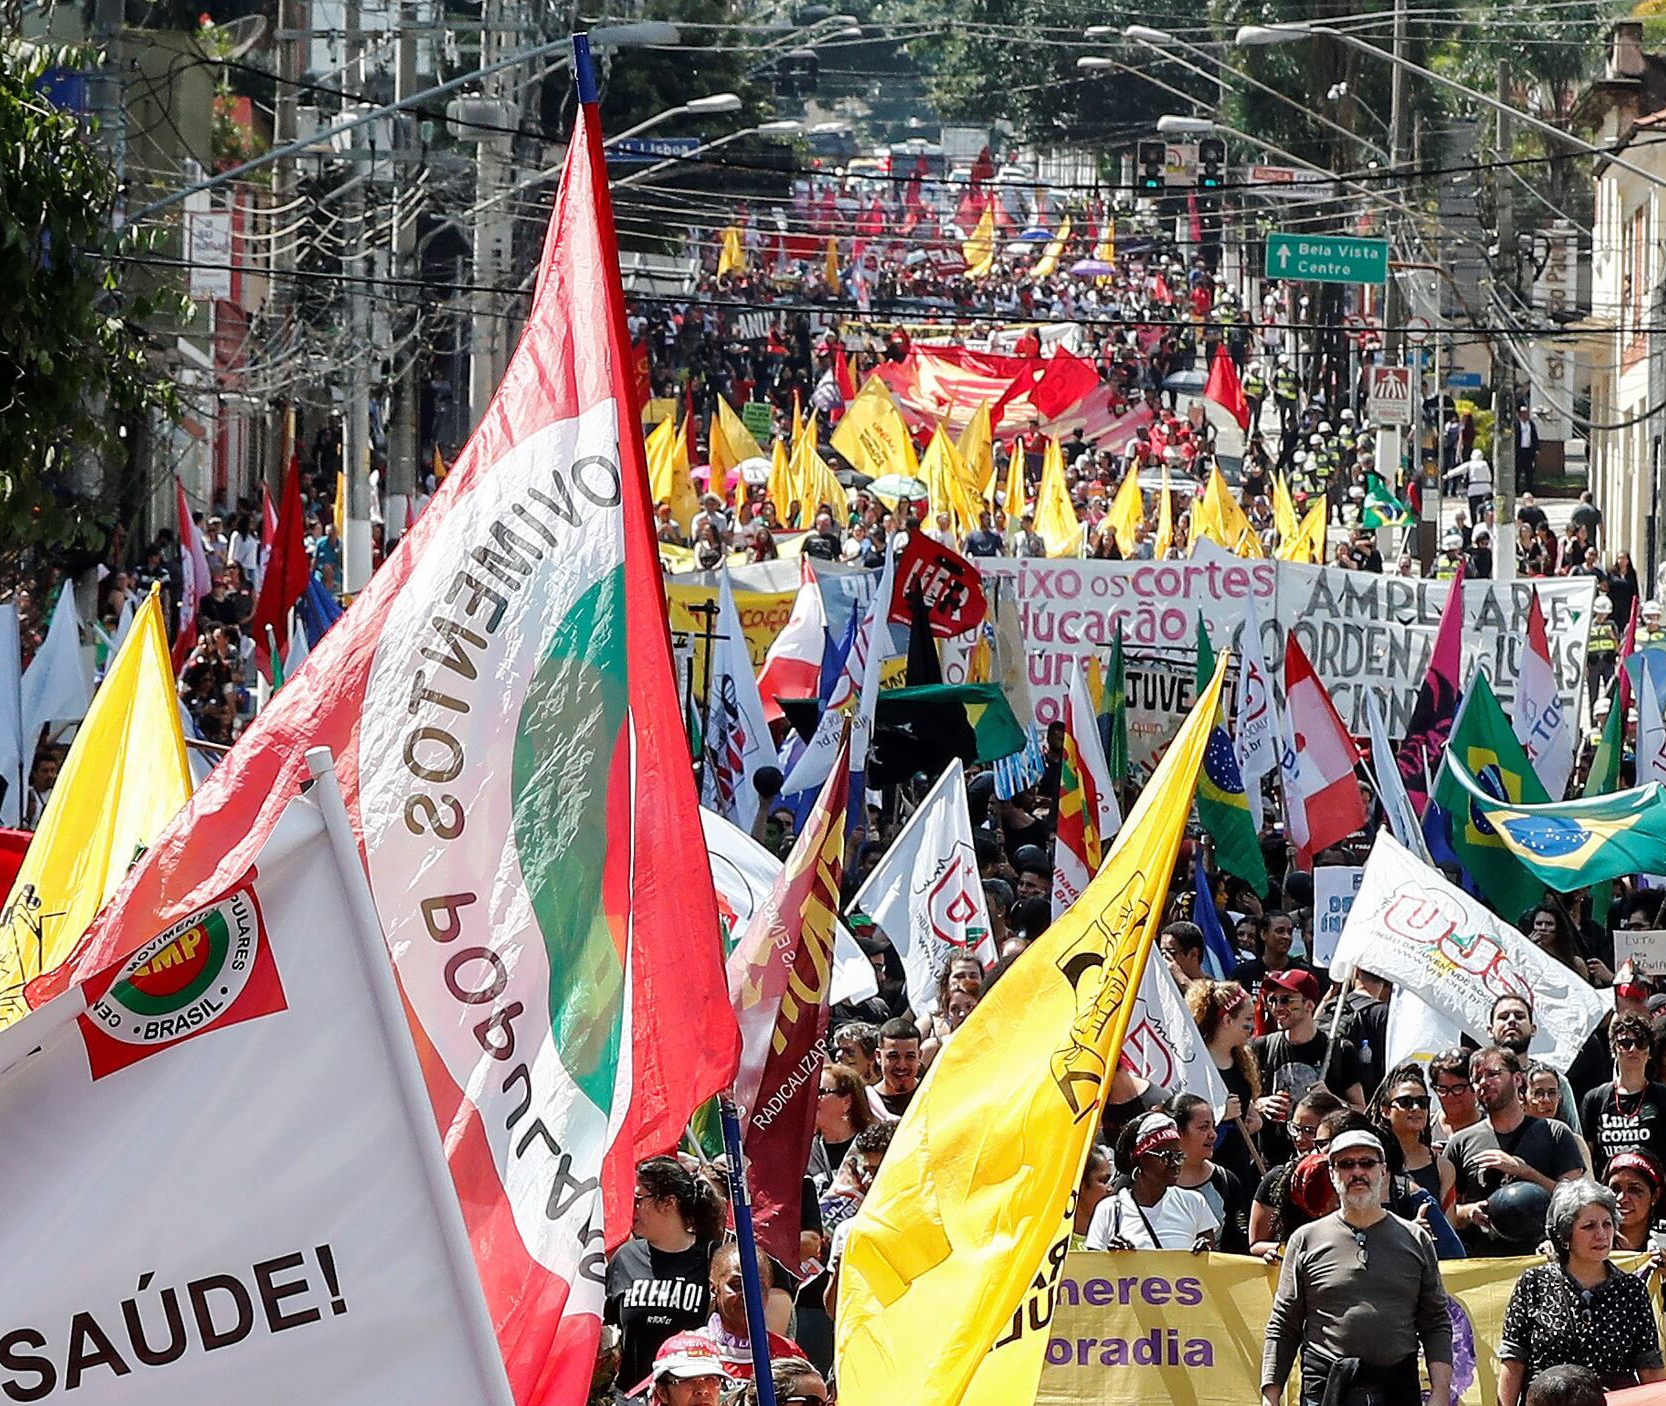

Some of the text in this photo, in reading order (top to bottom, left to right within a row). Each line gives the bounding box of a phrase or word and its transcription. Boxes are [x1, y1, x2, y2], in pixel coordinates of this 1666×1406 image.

[1298, 243, 1379, 260] Bela Vista
[1297, 261, 1351, 275] Centro
[1132, 561, 1276, 600] cortes
[143, 996, 224, 1041] BRASIL
[1601, 1127, 1652, 1143] como
